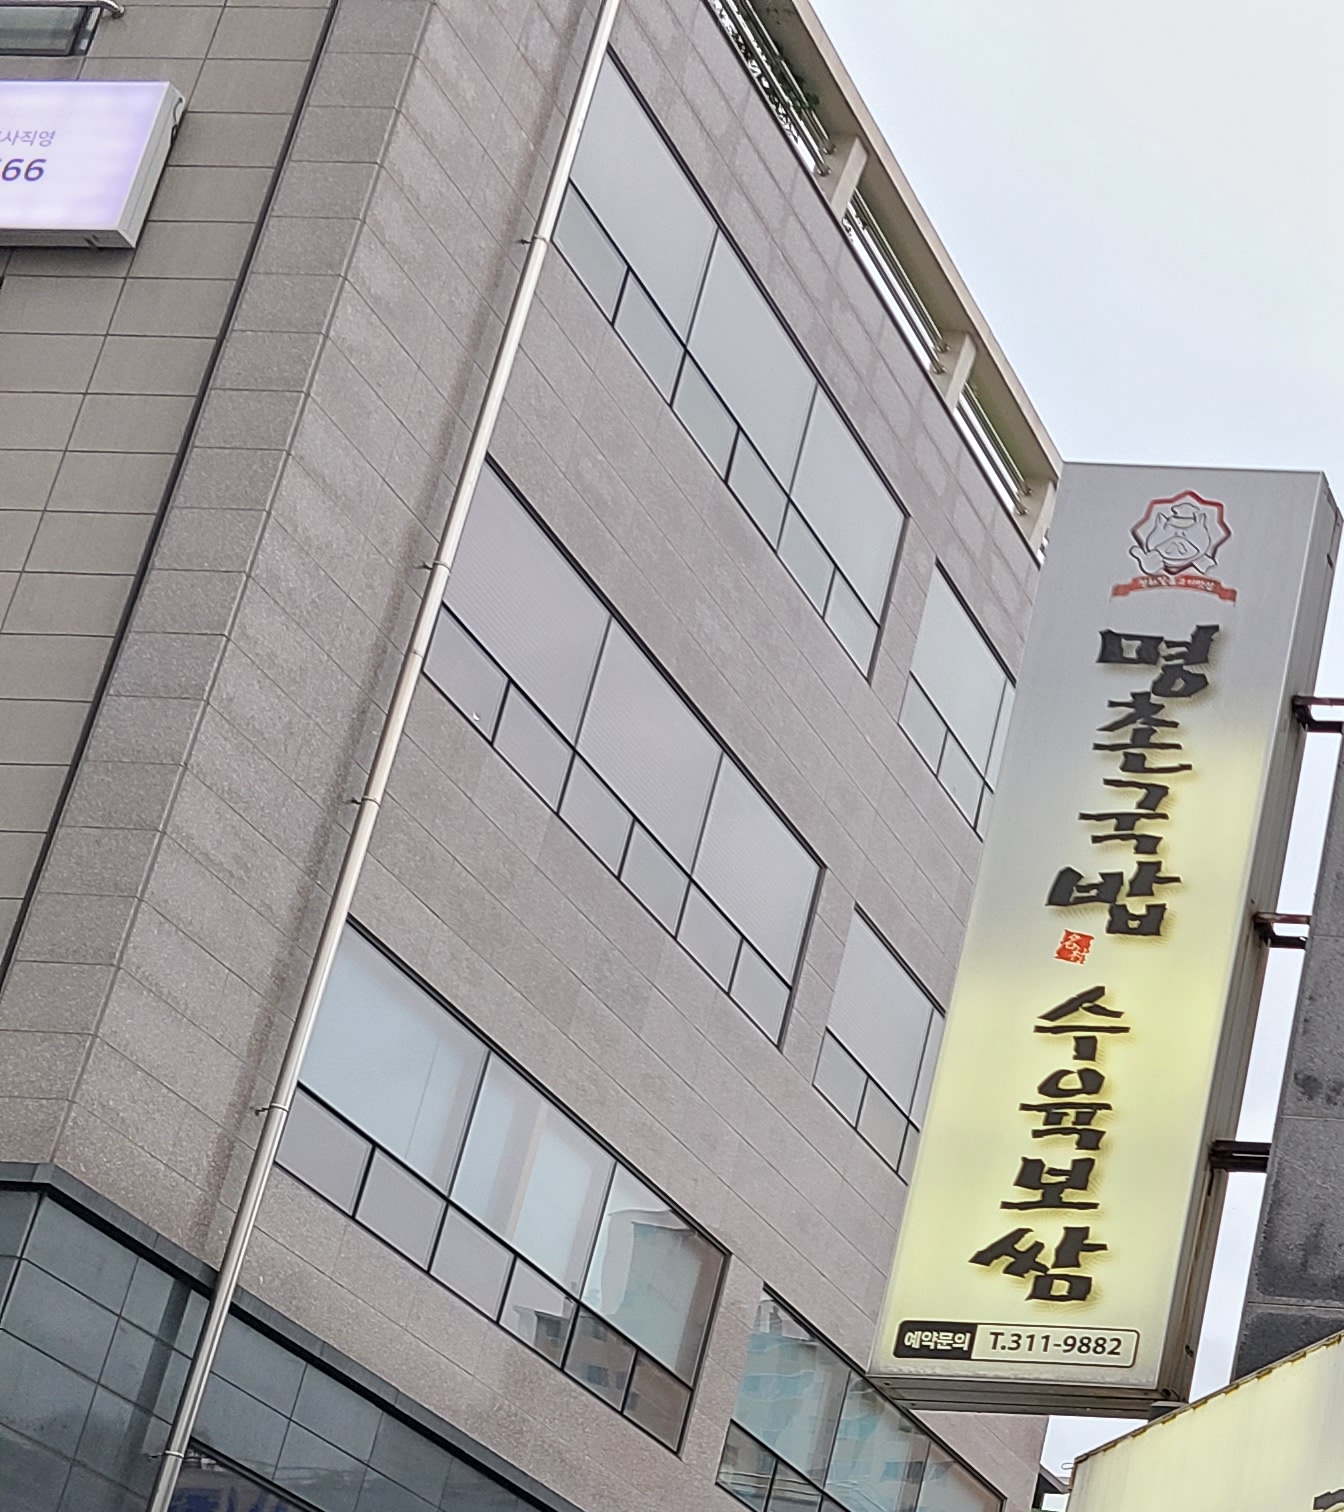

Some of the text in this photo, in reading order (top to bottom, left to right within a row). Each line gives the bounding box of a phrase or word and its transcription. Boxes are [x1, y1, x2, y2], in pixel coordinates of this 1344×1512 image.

[0, 130, 56, 147] 사직영
[0, 158, 47, 182] 66
[1046, 623, 1220, 937] 명촌국밥
[968, 984, 1131, 1303] 수육보쌈
[904, 1331, 1122, 1356] 예약문의 T.311-9882
